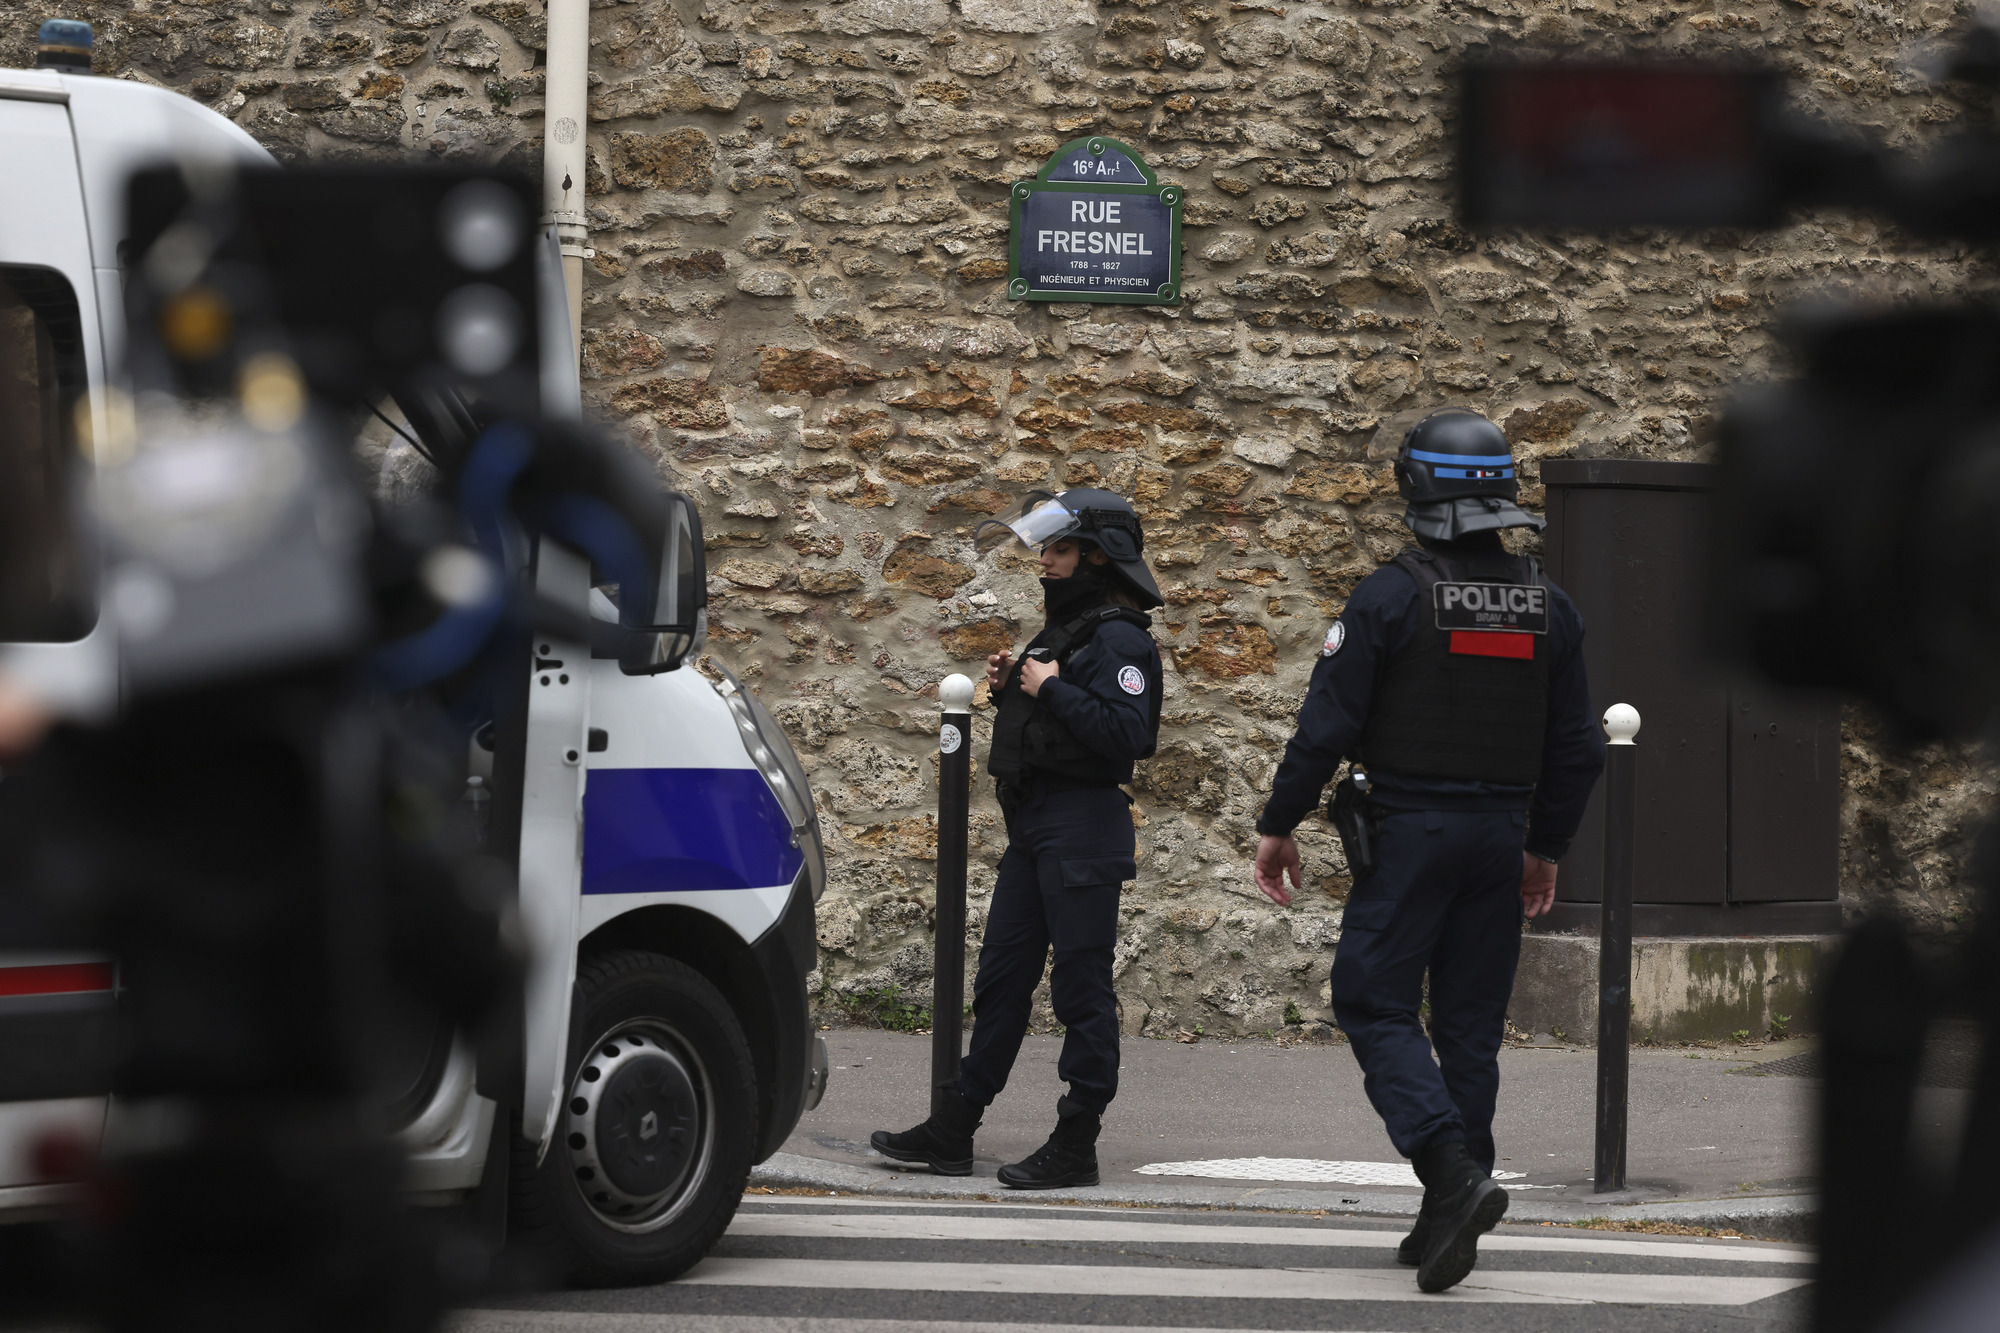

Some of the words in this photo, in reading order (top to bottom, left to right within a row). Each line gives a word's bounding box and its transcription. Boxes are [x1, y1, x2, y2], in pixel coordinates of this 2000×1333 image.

[1071, 200, 1121, 224] RUE
[1038, 230, 1153, 255] FRESNEL
[1070, 261, 1089, 269] 1788
[1102, 261, 1121, 270] 1827
[1040, 273, 1086, 285] INGÉNIEUR
[1089, 276, 1100, 285] ET
[1104, 277, 1149, 287] PHYSICIEN
[1443, 586, 1544, 615] POLICE
